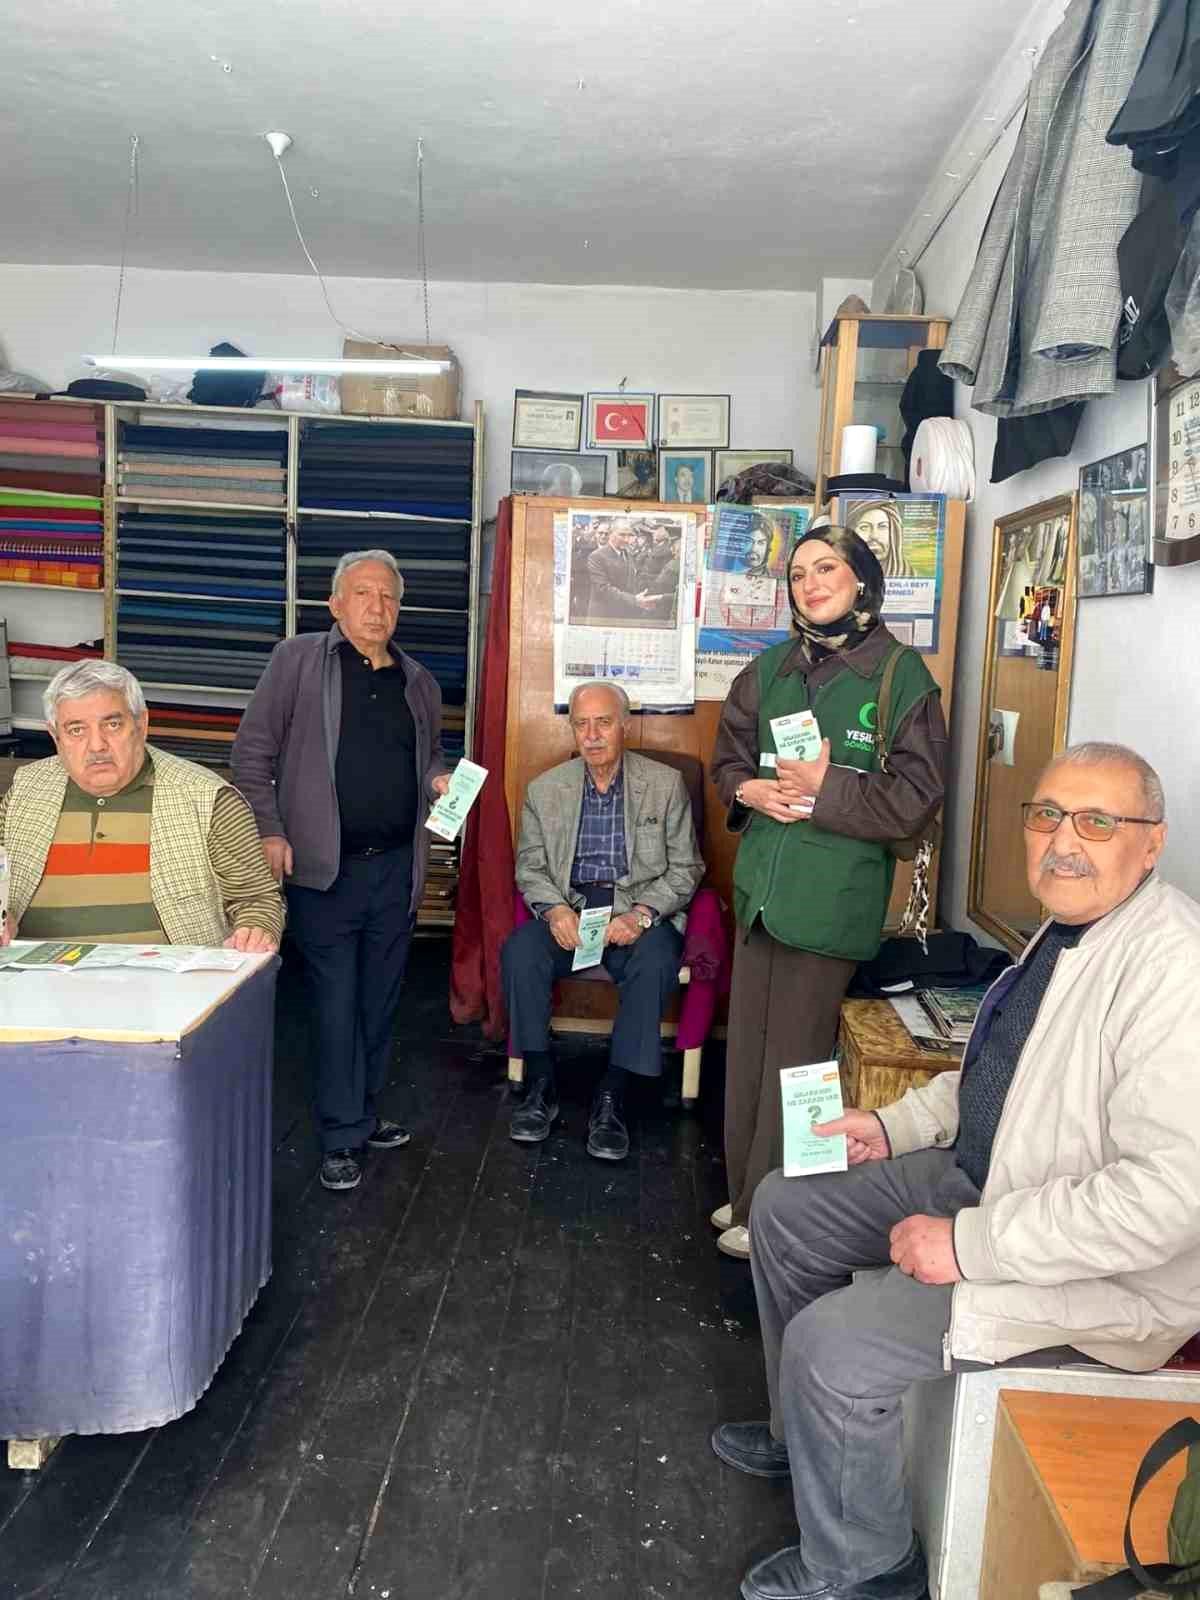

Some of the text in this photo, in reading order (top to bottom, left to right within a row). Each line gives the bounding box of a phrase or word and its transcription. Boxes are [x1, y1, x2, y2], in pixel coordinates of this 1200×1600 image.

[1190, 392, 1200, 409] 12
[1176, 402, 1185, 417] 11
[1172, 430, 1181, 446] 10
[1172, 460, 1178, 475] 9
[1171, 488, 1178, 503] 8
[1172, 515, 1179, 529] 7
[1188, 512, 1196, 528] 6
[807, 1105, 822, 1124] ?
